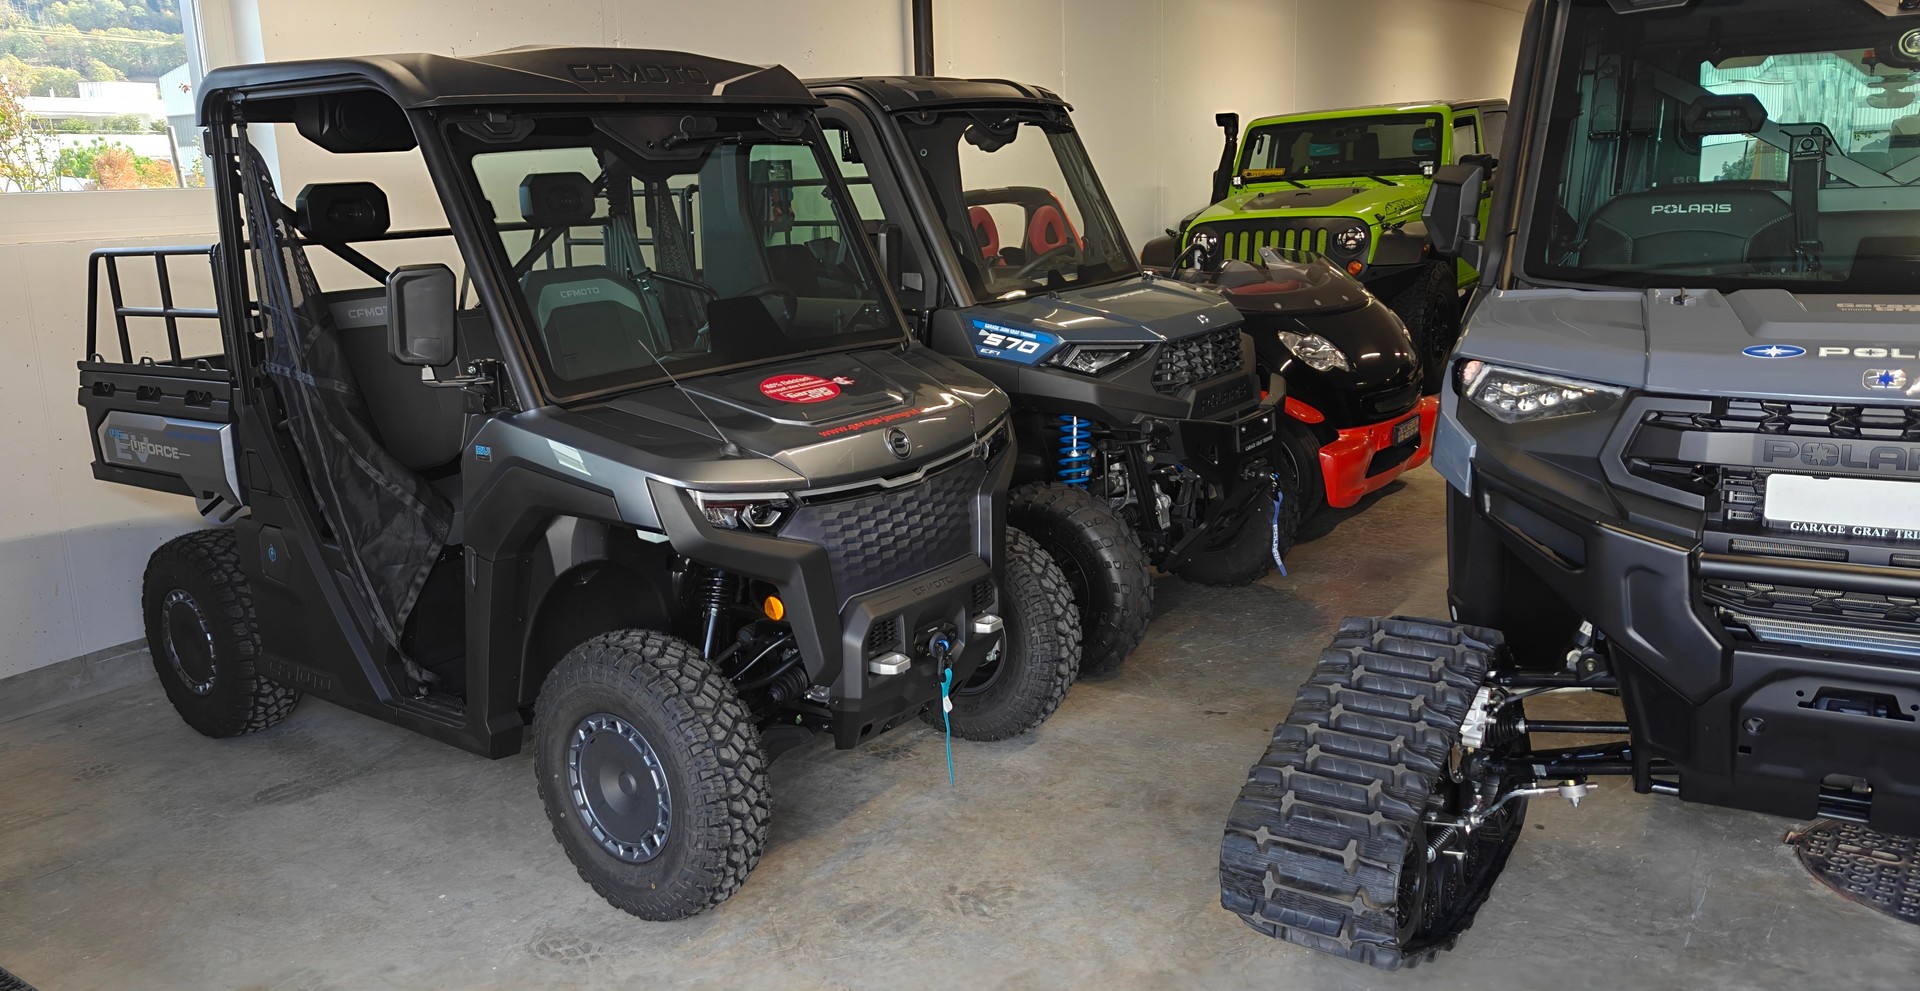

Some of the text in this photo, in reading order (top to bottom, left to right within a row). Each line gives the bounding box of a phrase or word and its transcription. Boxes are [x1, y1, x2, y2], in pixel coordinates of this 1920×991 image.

[567, 63, 709, 85] CFMOTO
[1651, 203, 1732, 214] POLARIS
[560, 286, 600, 298] CFMOTO
[348, 305, 388, 318] CFMOT
[982, 333, 1040, 353] 570
[1818, 346, 1920, 359] POL
[1790, 521, 1846, 534] GARAGE
[1852, 526, 1890, 538] GRAF
[912, 575, 954, 596] CFMOTO
